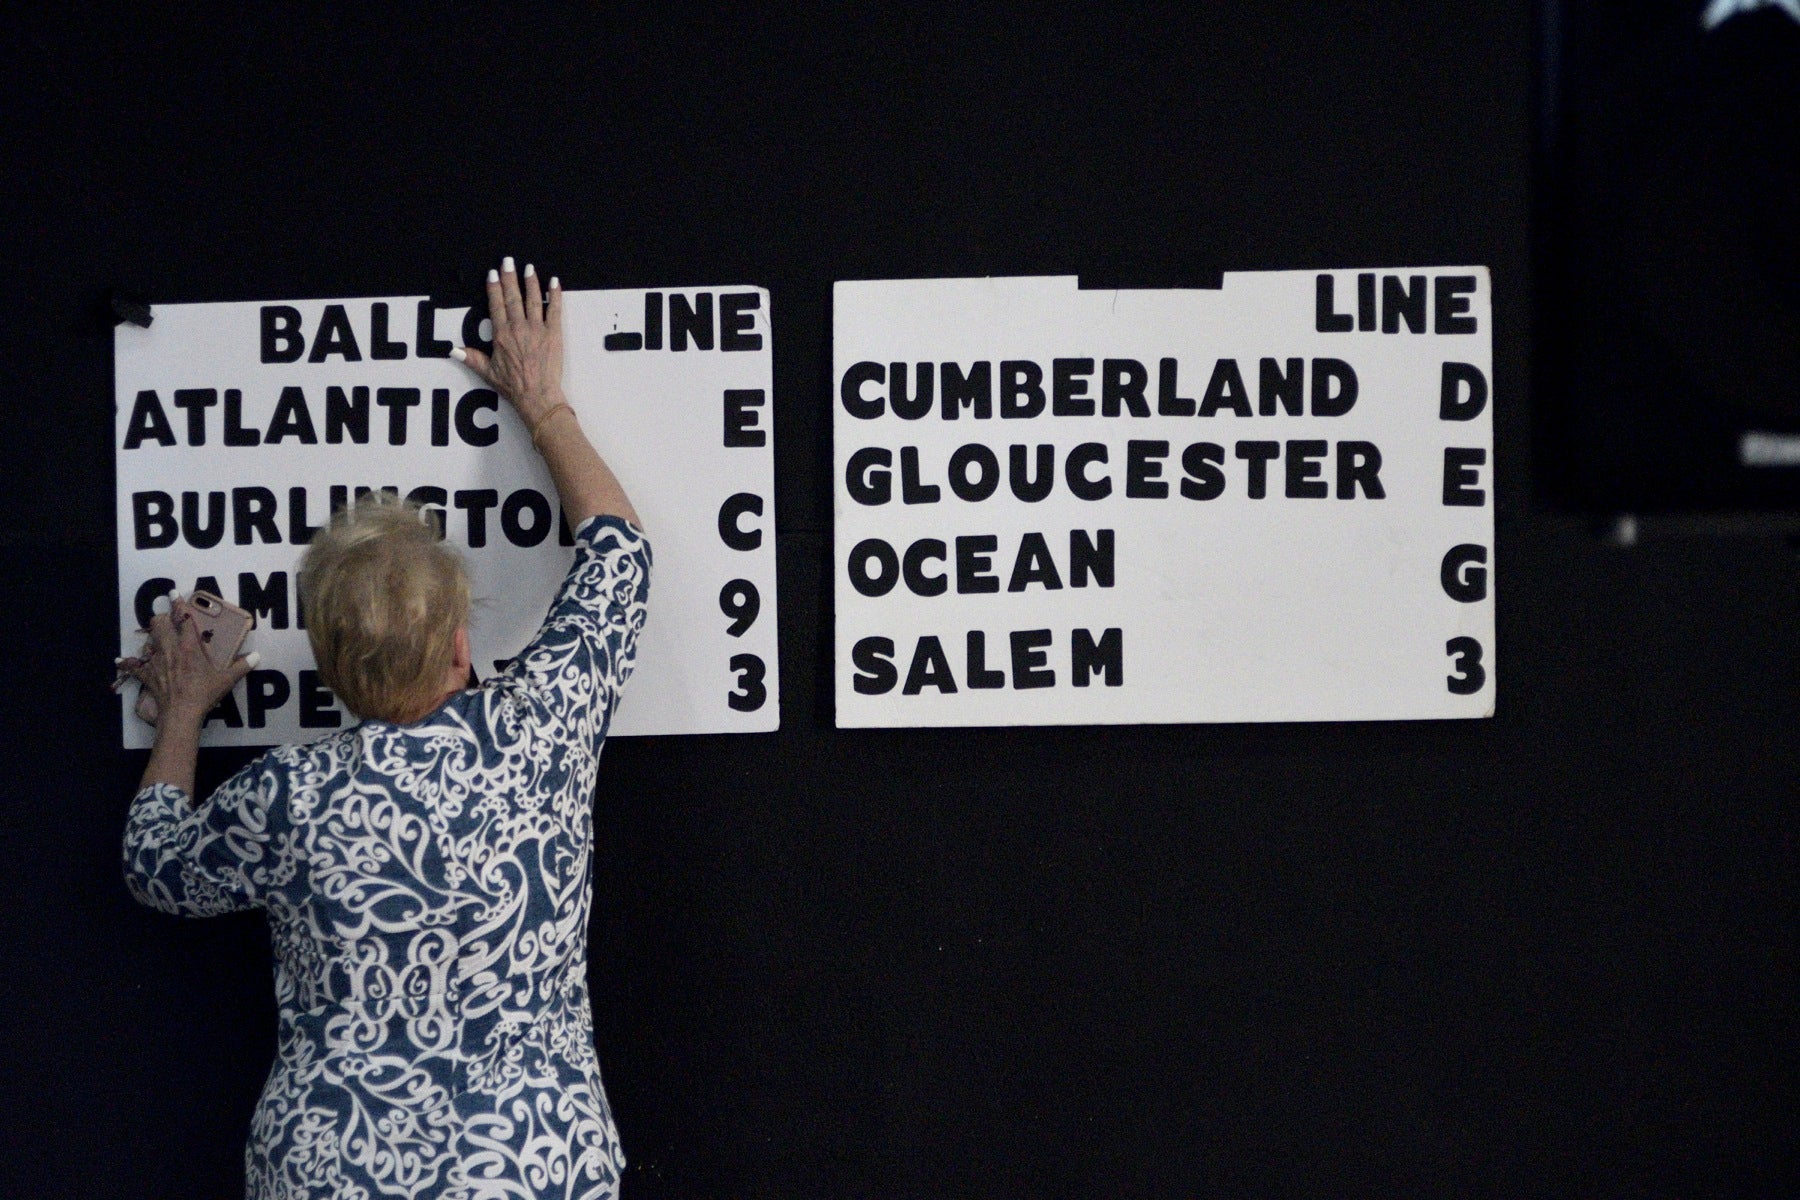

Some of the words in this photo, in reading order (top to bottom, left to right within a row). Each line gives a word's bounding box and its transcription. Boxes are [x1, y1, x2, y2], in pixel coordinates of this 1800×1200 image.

[1316, 273, 1477, 334] LINE
[123, 386, 499, 449] ATLANTIC
[723, 389, 766, 447] E
[840, 357, 1359, 421] CUMBERLAND
[1439, 362, 1488, 421] D
[845, 440, 1386, 506] GLOUCESTER
[1443, 447, 1487, 506] E
[718, 492, 763, 551] C
[847, 529, 1115, 597] OCEAN
[1440, 543, 1487, 603] G
[719, 578, 760, 637] 9
[728, 653, 767, 712] 3
[851, 627, 1123, 696] SALEM
[1446, 636, 1485, 695] 3
